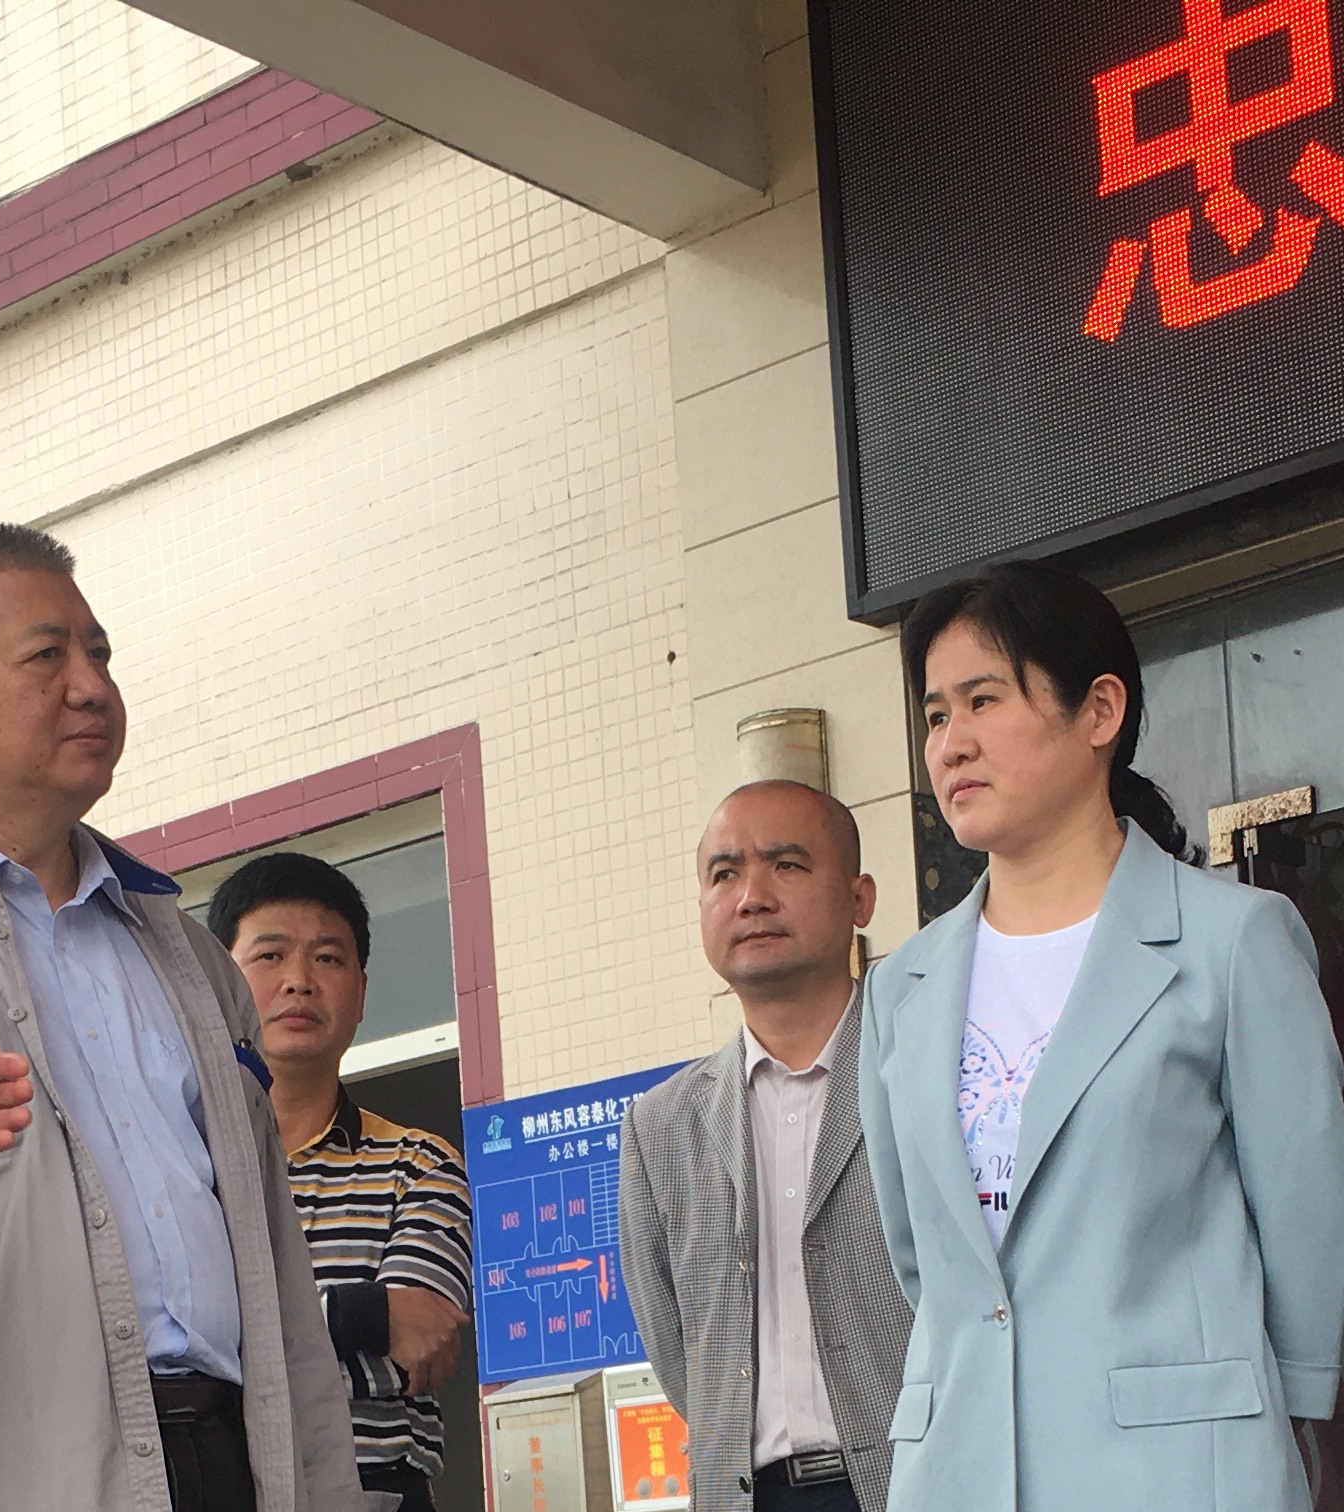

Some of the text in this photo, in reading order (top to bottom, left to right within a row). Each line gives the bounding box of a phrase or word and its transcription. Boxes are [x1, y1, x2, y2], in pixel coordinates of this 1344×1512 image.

[501, 1198, 586, 1231] 103 102 101
[488, 1269, 506, 1287] 104
[508, 1309, 593, 1341] 105 106 107
